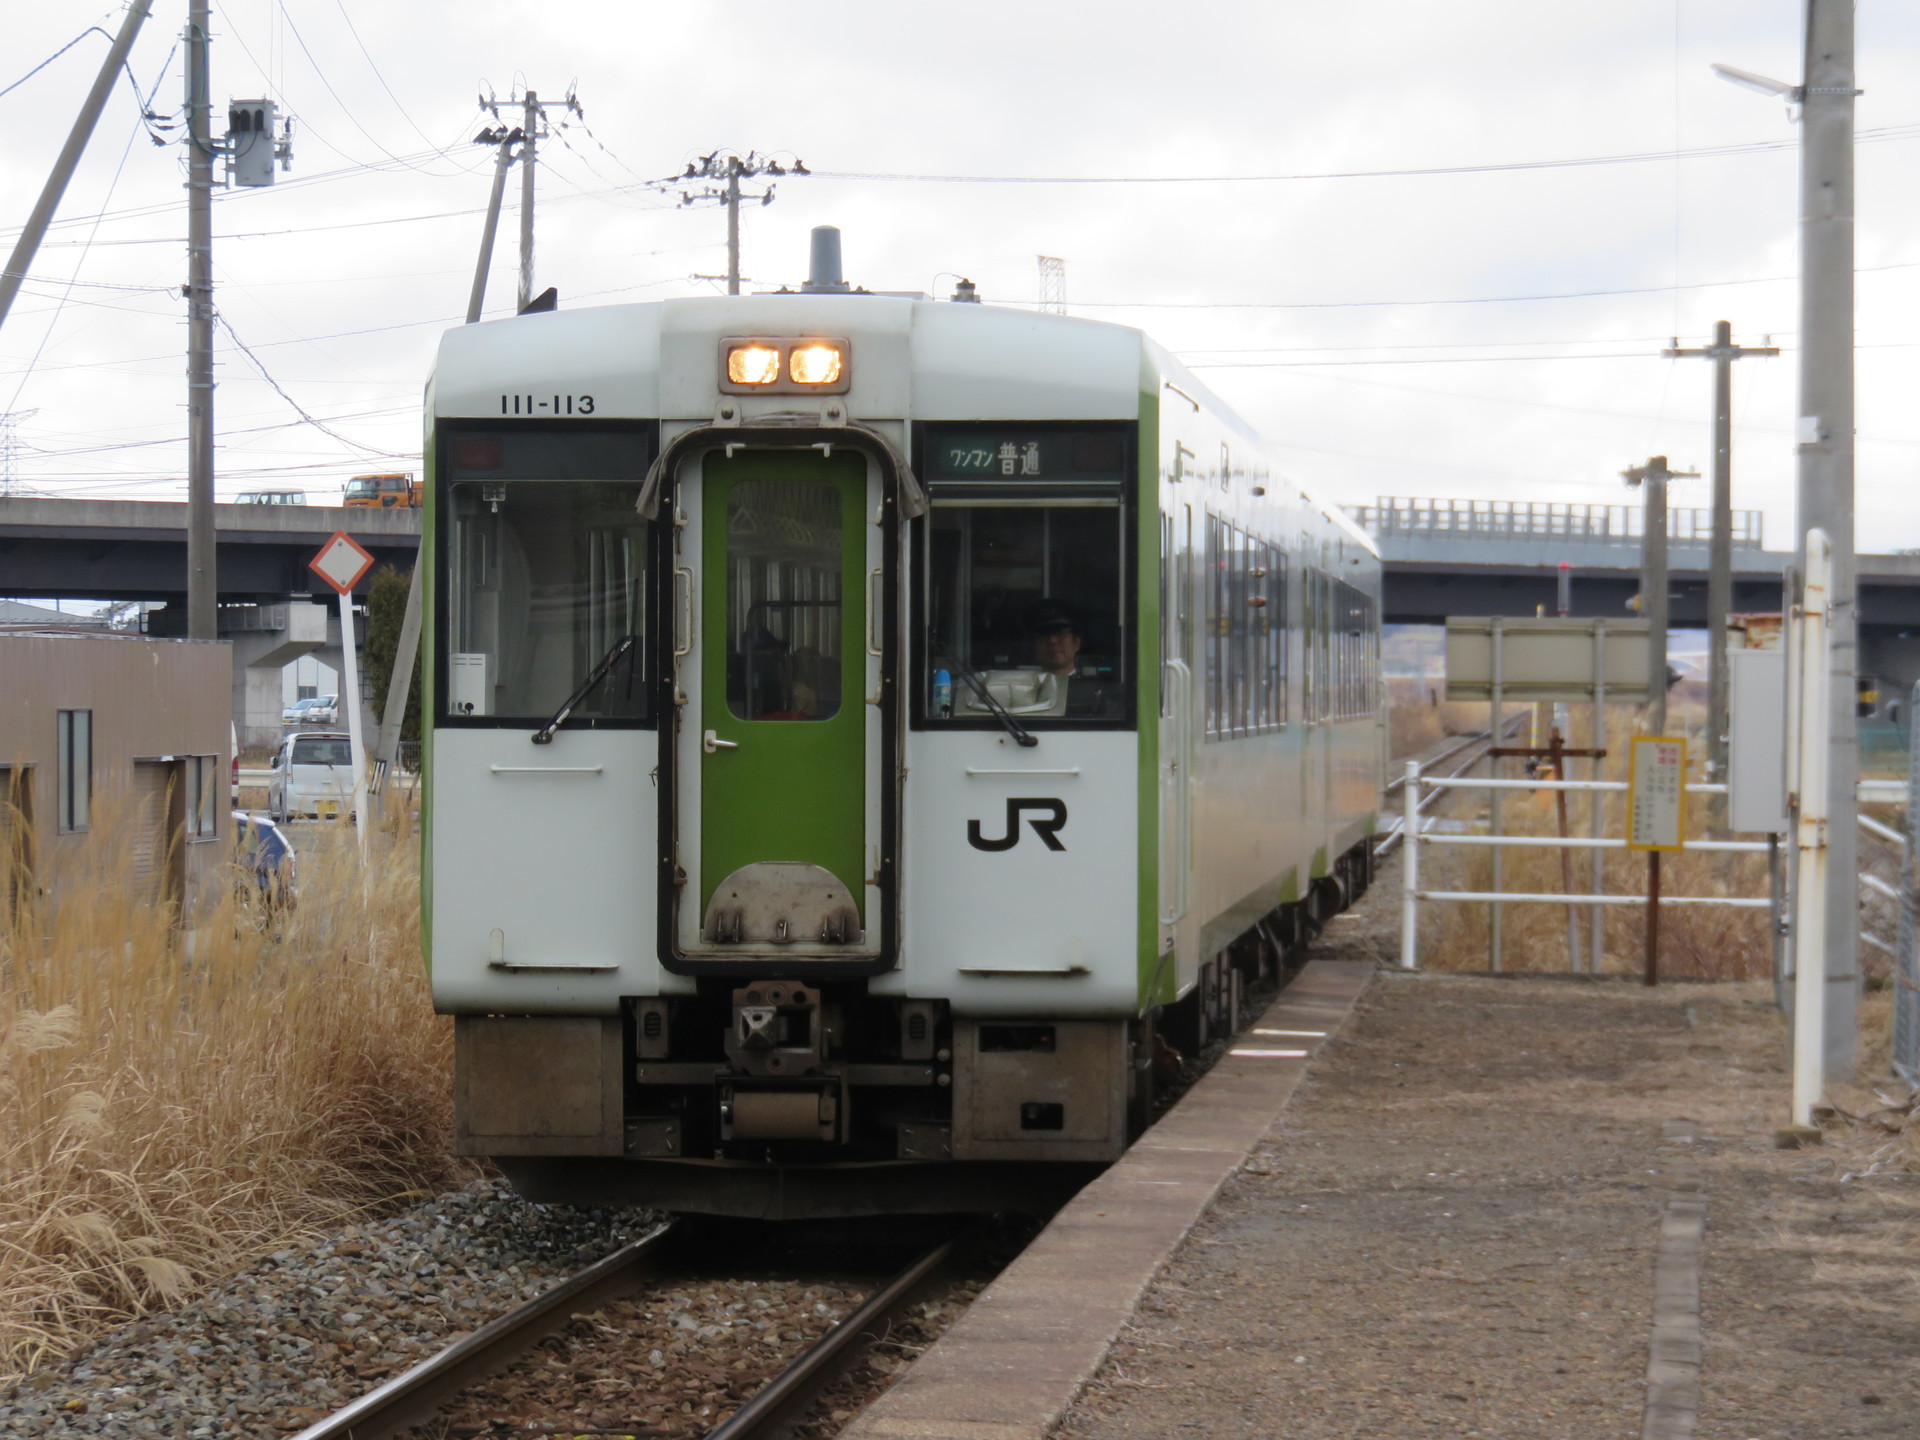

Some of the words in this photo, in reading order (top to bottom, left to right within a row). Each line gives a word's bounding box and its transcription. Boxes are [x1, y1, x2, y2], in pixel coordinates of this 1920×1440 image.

[501, 395, 595, 415] 111-113
[950, 449, 993, 468] ワンマン
[998, 442, 1041, 475] 普通
[967, 797, 1068, 852] JR
